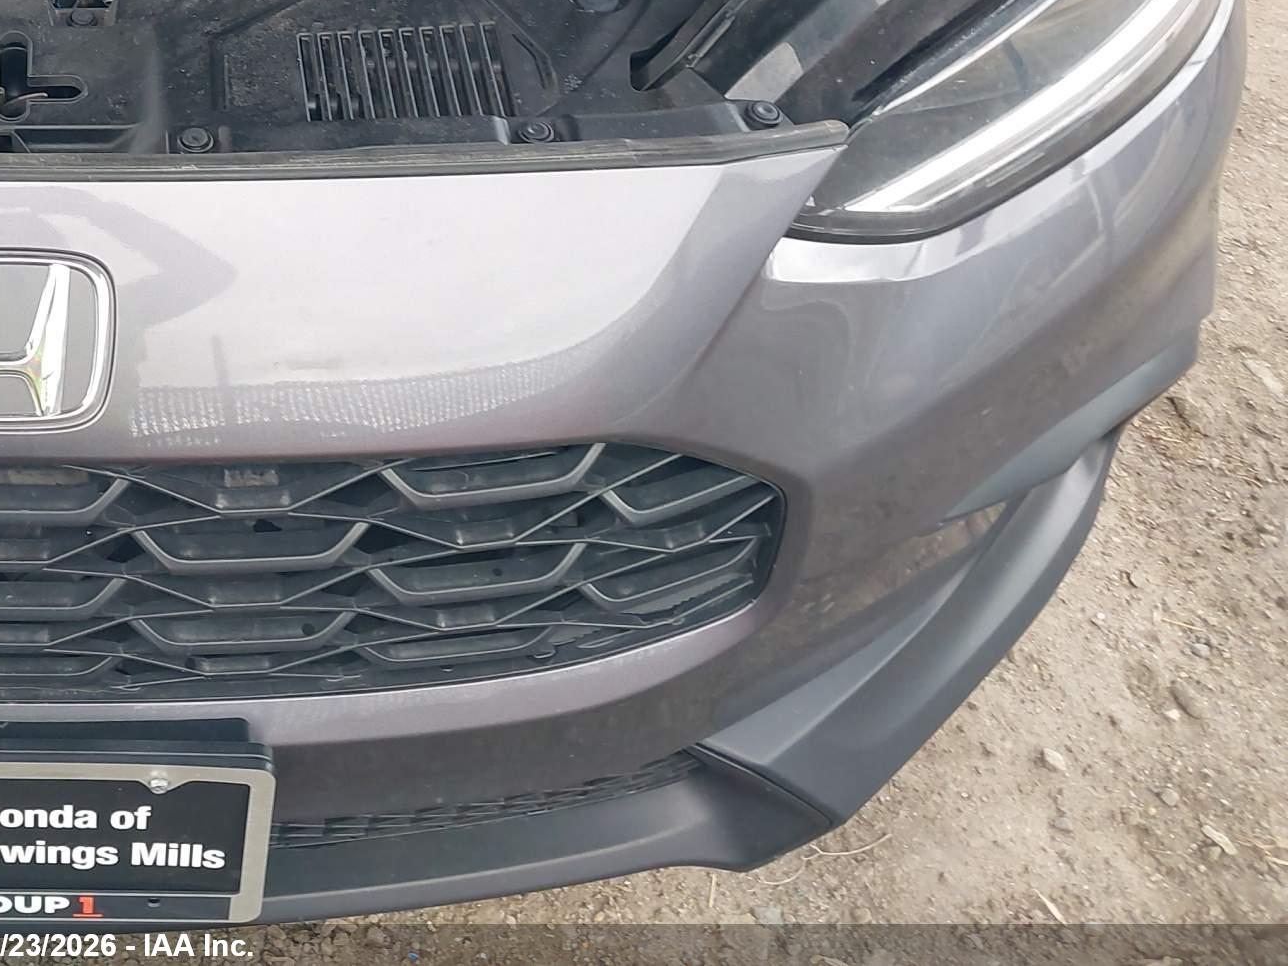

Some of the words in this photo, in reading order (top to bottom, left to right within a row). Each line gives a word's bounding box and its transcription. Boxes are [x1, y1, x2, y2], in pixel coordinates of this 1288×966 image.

[109, 805, 152, 829] of
[130, 841, 226, 870] Mills
[73, 895, 103, 918] 1
